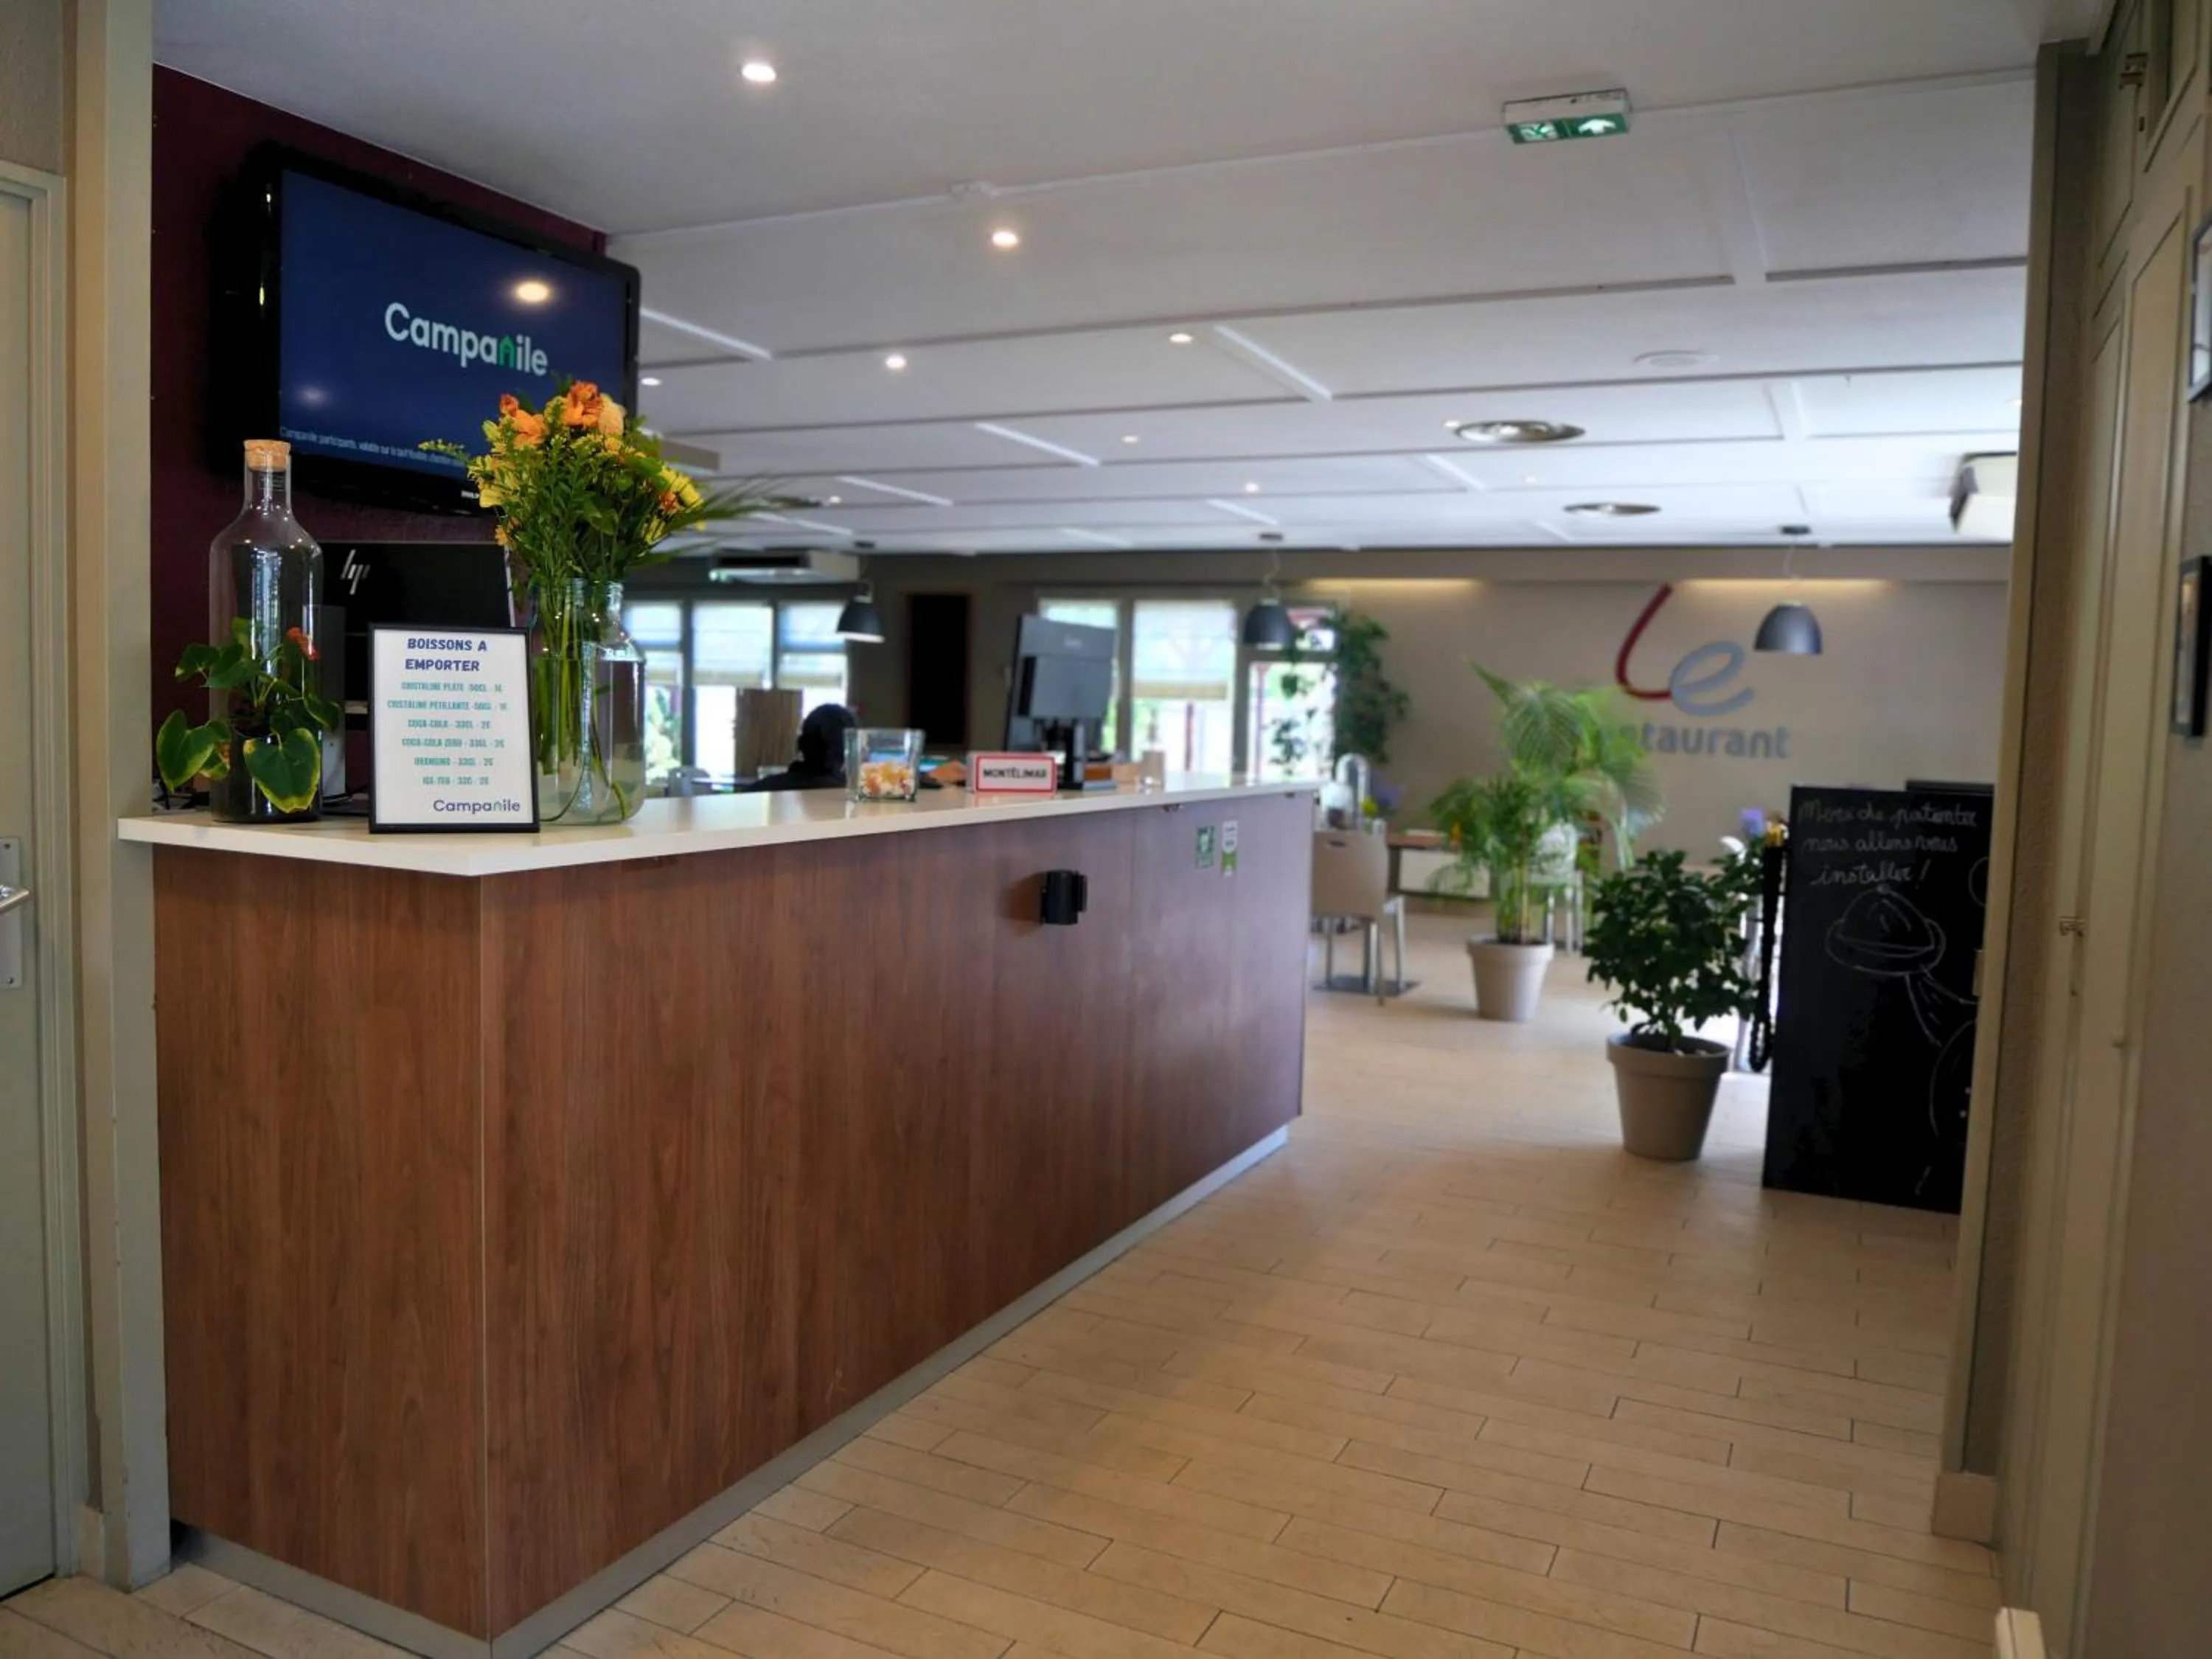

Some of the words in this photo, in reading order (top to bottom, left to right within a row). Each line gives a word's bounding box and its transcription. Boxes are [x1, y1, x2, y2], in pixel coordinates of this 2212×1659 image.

[384, 302, 549, 377] Campanile
[341, 549, 370, 595] hp
[407, 638, 473, 651] BOISSONS
[477, 641, 487, 652] A
[406, 658, 481, 672] EMPORTER
[433, 799, 521, 815] Campanile
